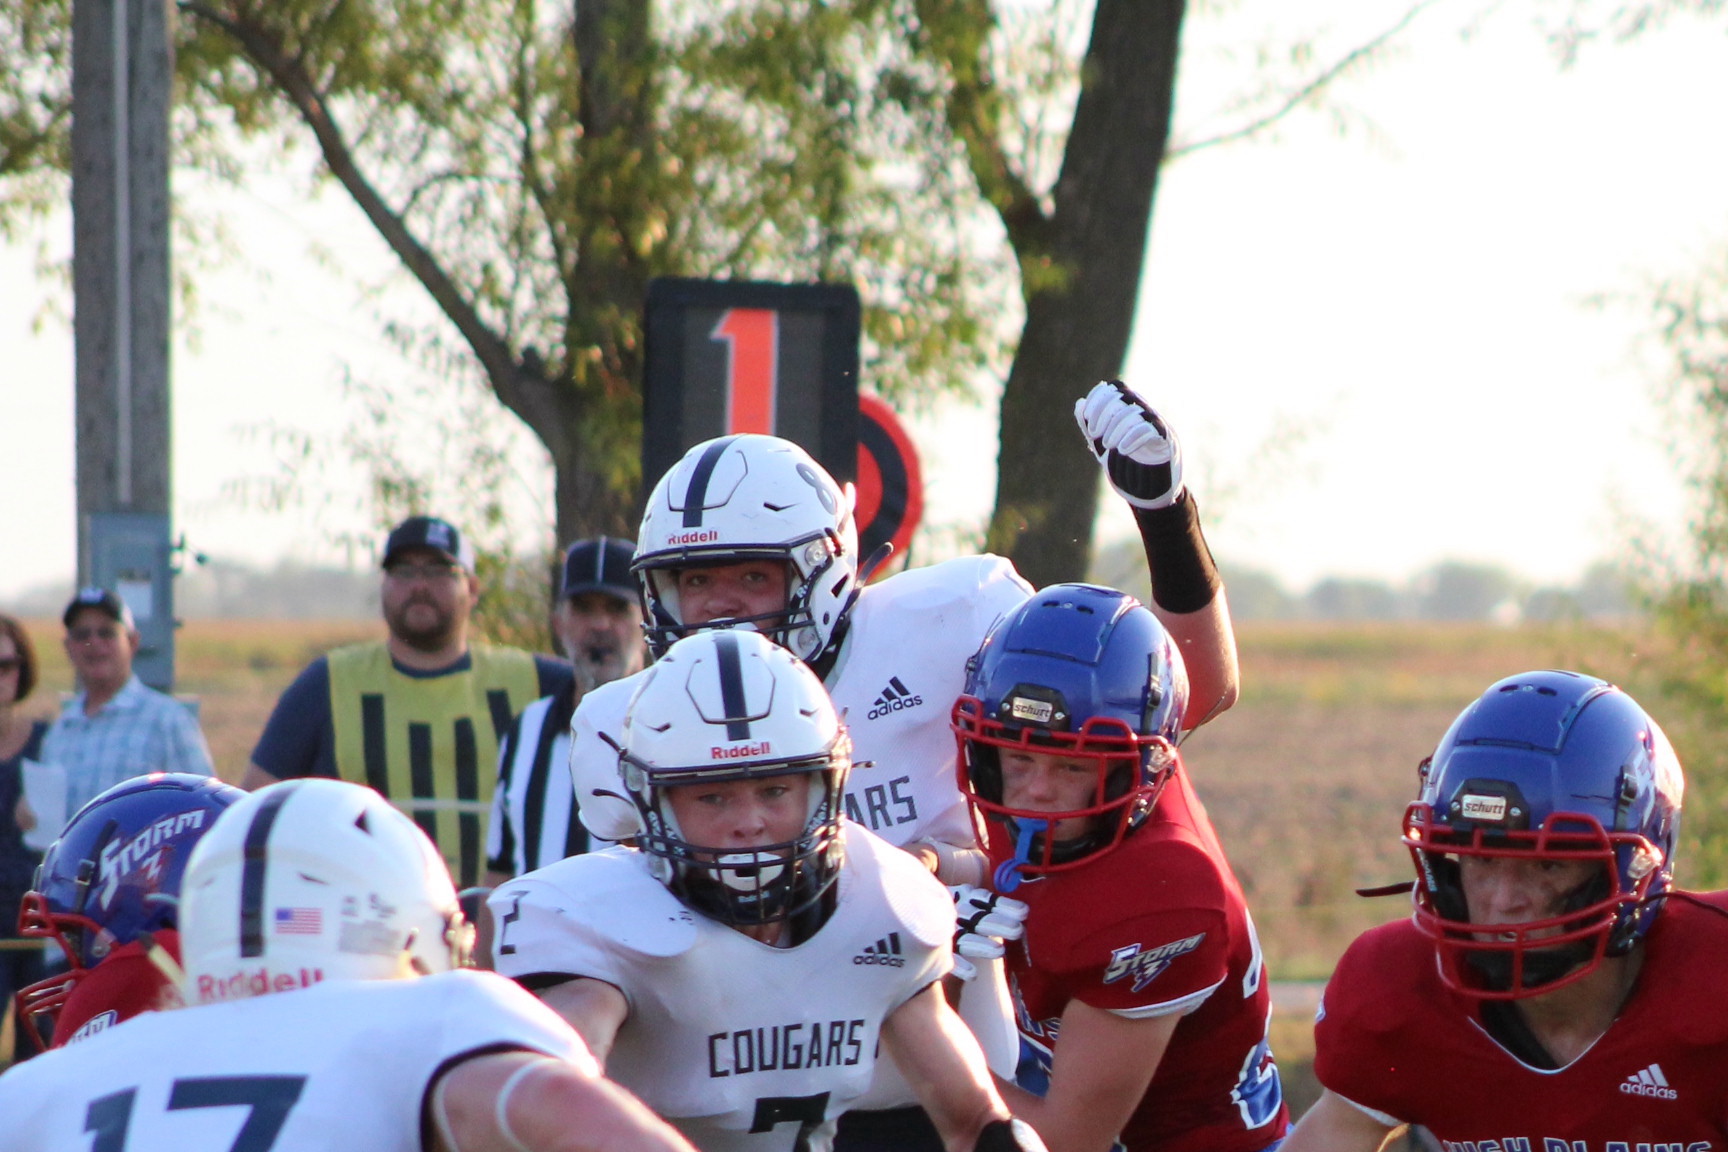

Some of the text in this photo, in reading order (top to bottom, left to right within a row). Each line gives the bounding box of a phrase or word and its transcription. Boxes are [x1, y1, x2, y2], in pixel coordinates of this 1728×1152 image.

[709, 307, 779, 435] 1
[668, 530, 718, 545] Riddell
[867, 694, 923, 721] adidas
[711, 741, 771, 760] Riddell
[853, 950, 906, 968] adidas
[197, 967, 323, 1000] Riddell
[708, 1018, 865, 1078] COUGARS
[1619, 1080, 1678, 1100] adidas
